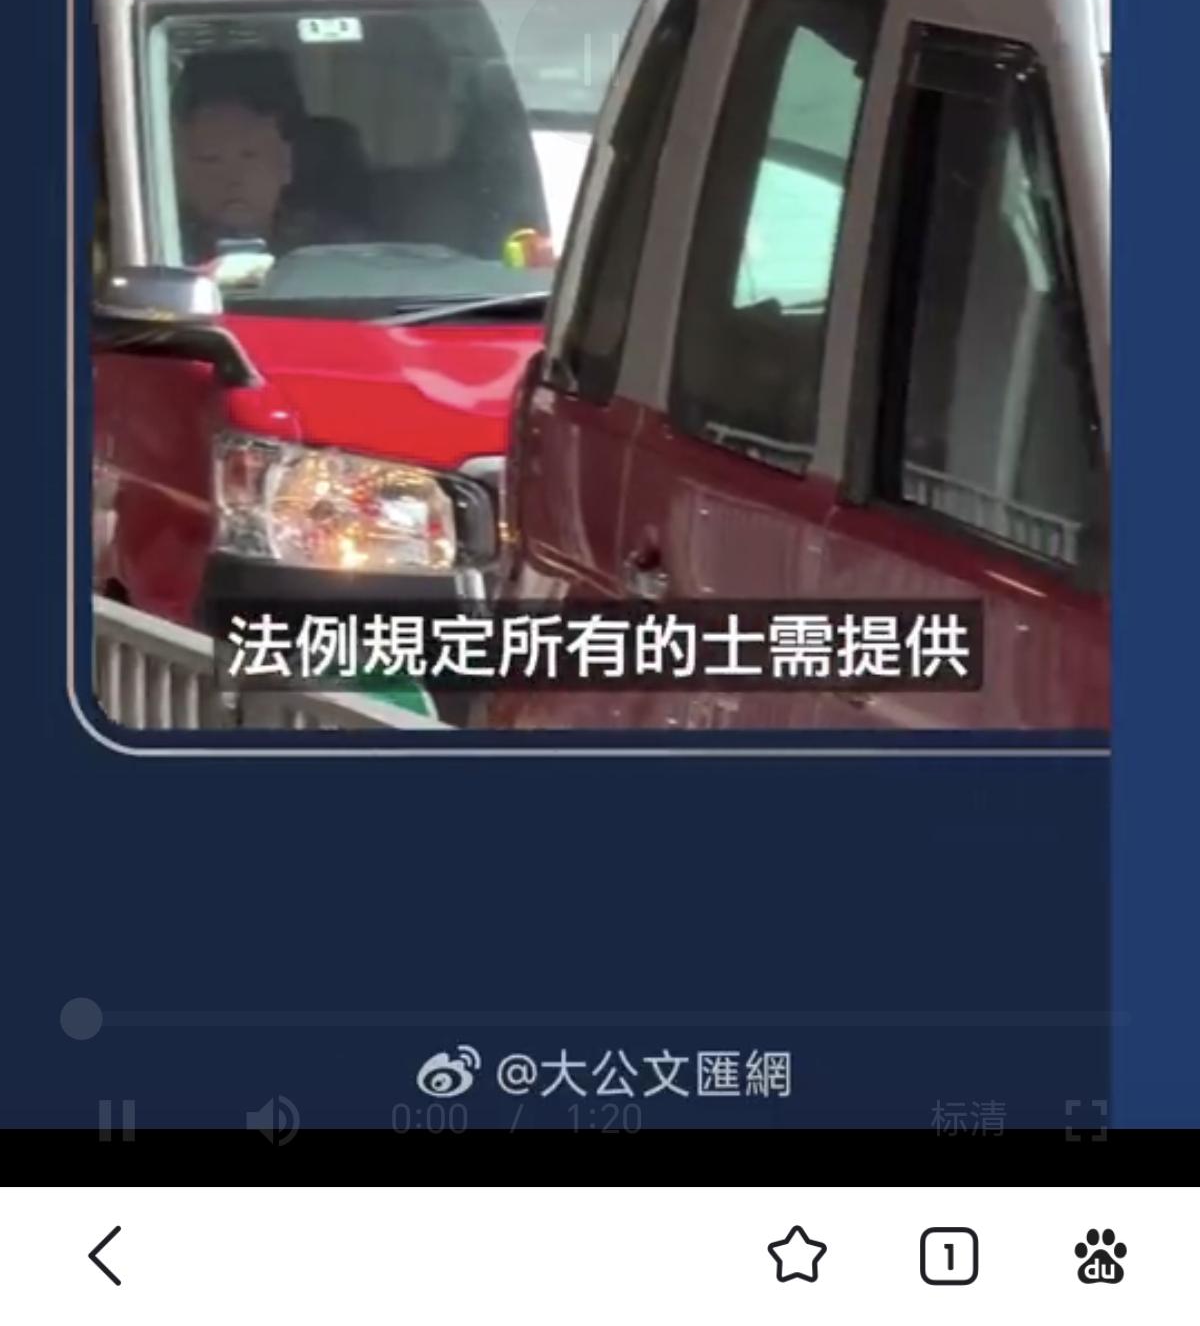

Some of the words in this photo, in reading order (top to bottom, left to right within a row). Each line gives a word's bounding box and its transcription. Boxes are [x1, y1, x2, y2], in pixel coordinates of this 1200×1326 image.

[391, 1102, 468, 1135] 0:00
[567, 1102, 642, 1135] 1:20
[930, 1098, 1005, 1138] 标清
[942, 1243, 956, 1272] 1
[1084, 1258, 1115, 1279] du
